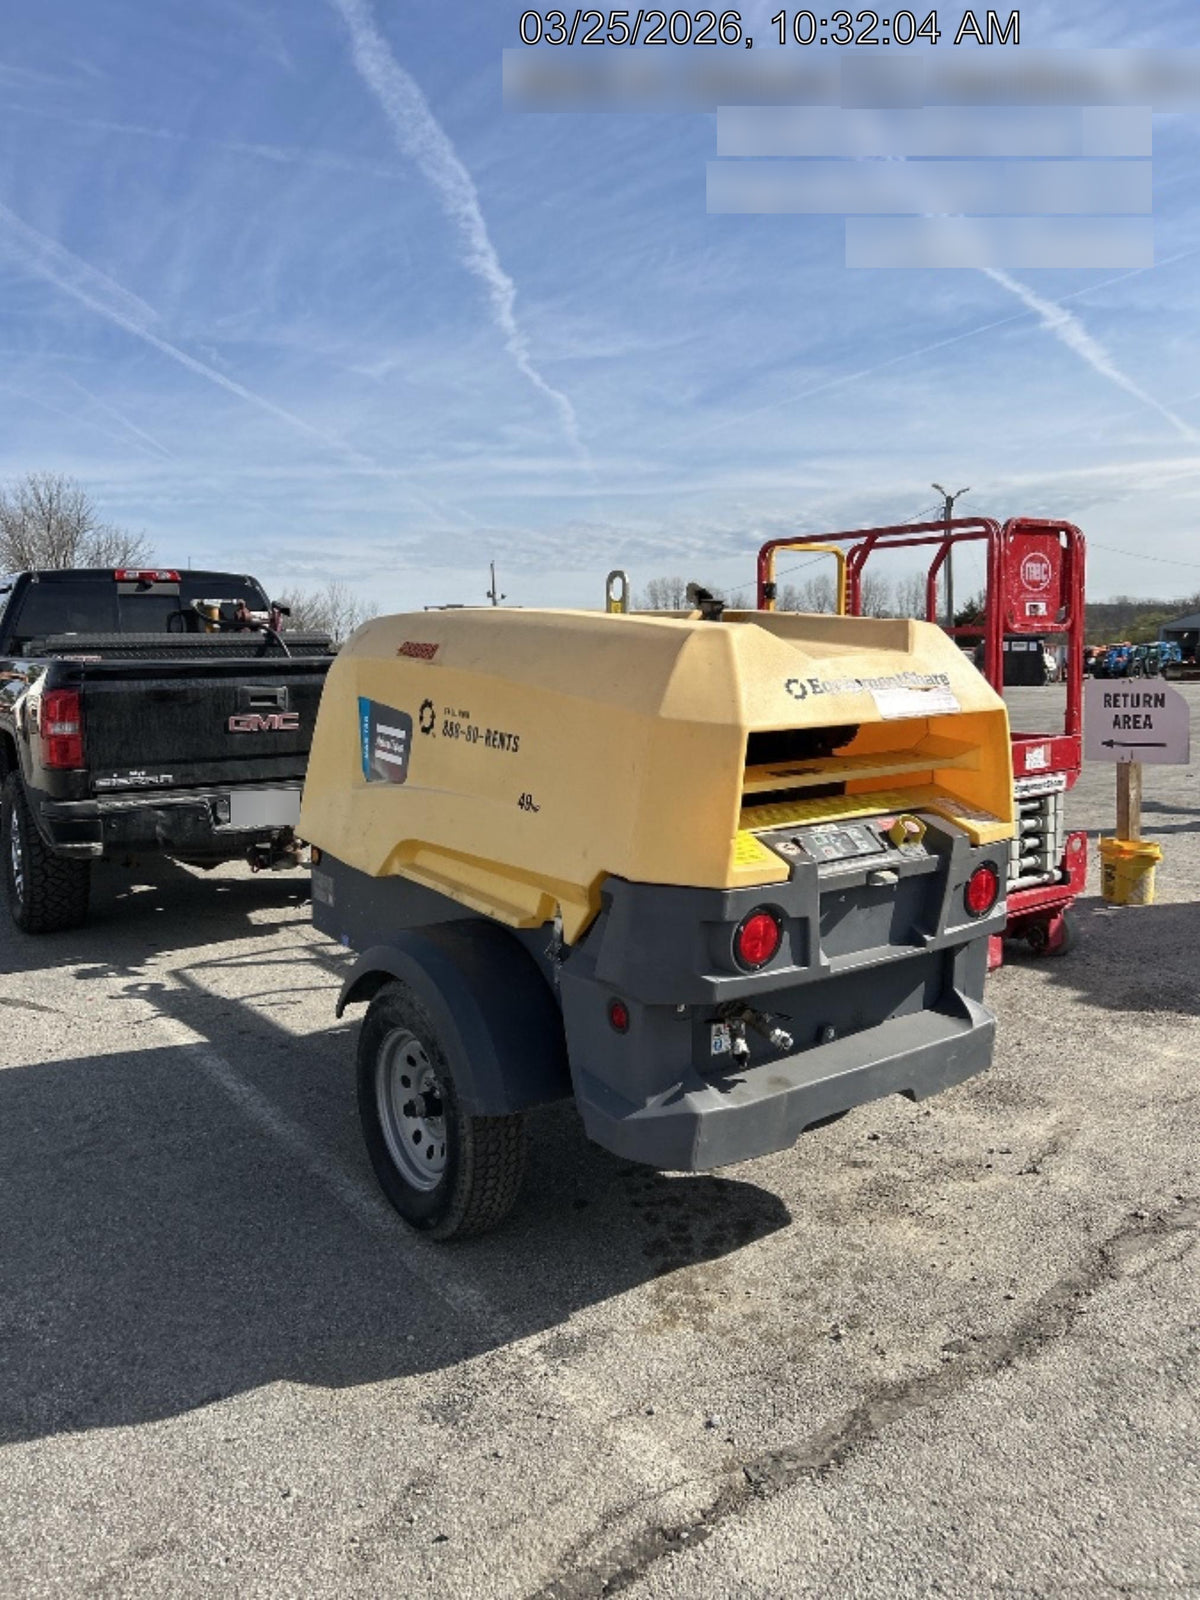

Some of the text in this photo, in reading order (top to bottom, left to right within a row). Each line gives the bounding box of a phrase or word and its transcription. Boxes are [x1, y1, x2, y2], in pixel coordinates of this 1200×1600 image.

[806, 671, 950, 696] EqmentShare
[1103, 692, 1166, 708] RETURN
[228, 712, 299, 732] GMC
[1112, 714, 1153, 729] AREA
[442, 720, 520, 752] 888-80-RENTS
